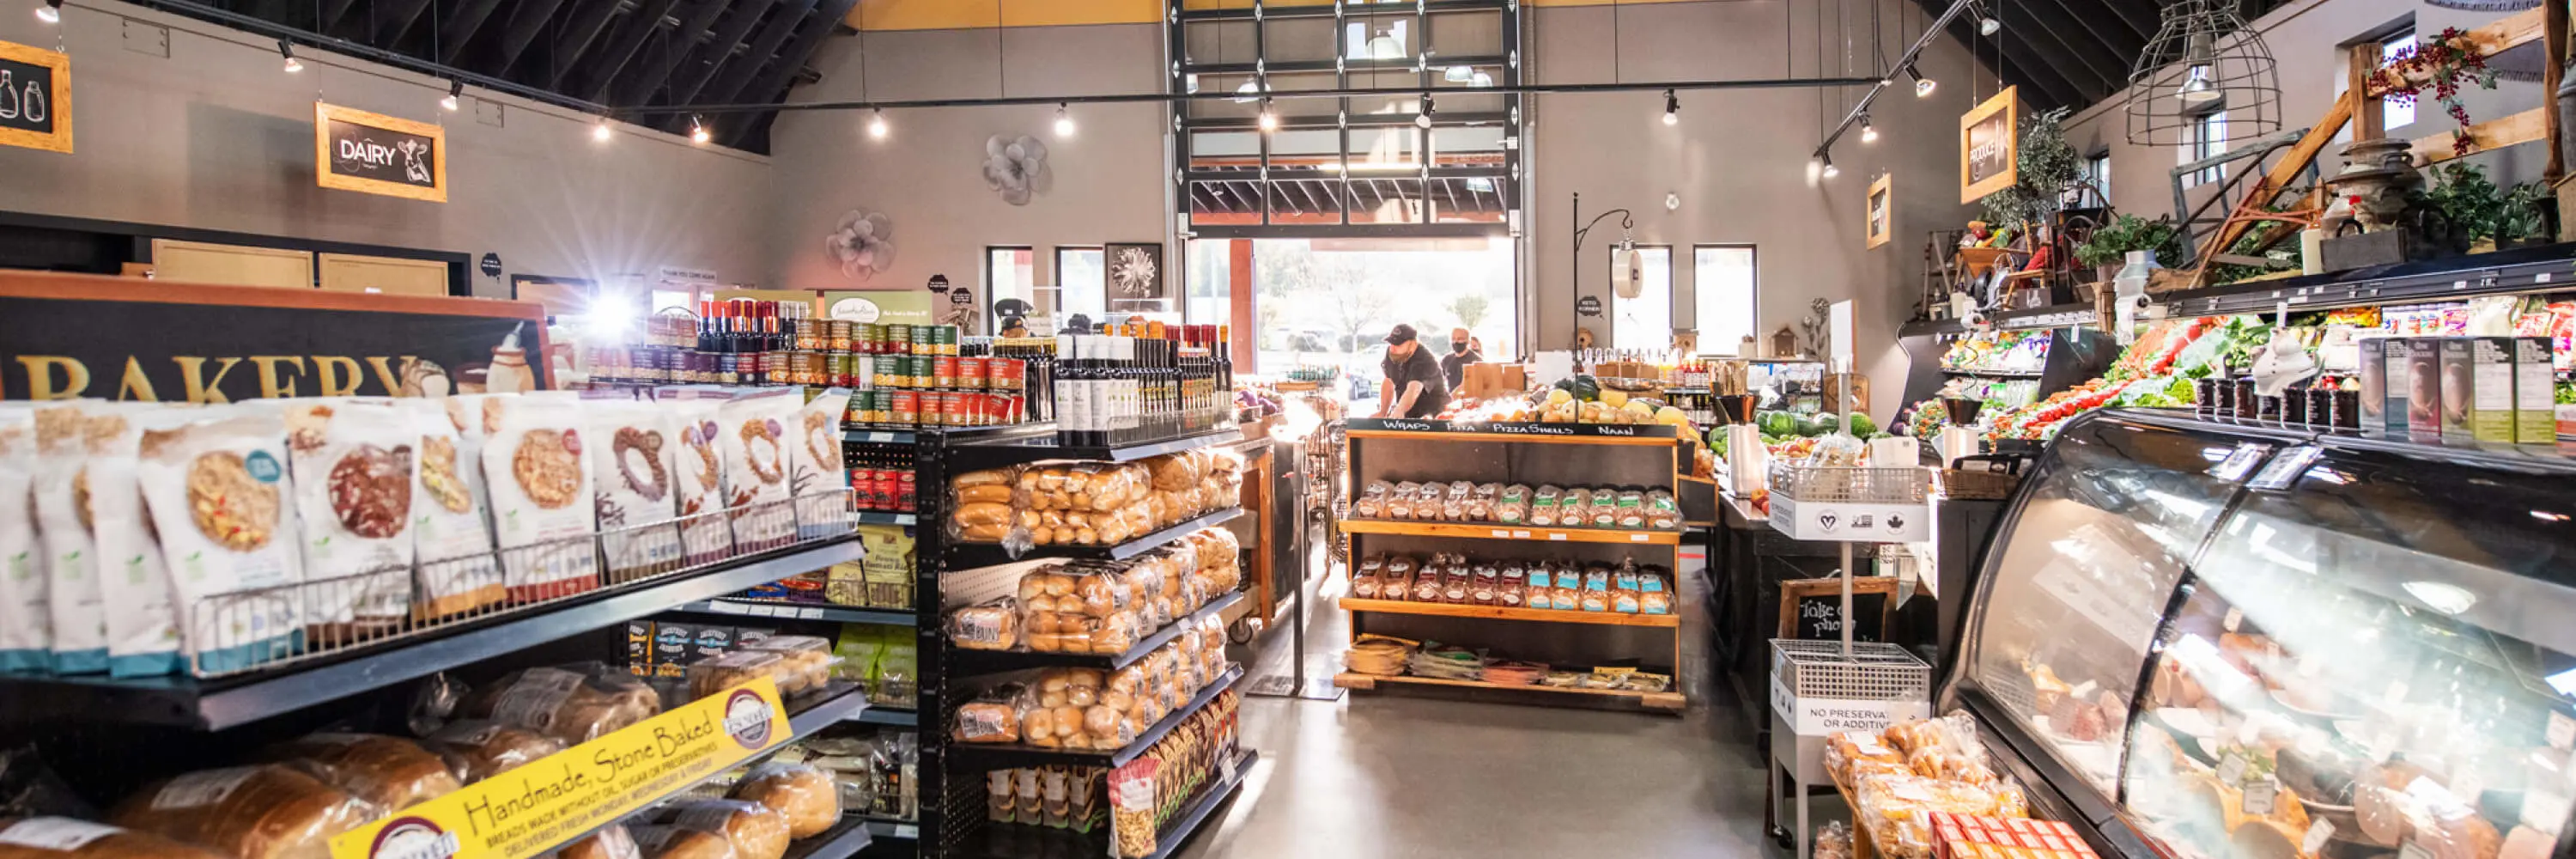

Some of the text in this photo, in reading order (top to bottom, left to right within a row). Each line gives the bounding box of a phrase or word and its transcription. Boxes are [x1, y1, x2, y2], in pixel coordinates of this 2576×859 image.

[339, 138, 396, 166] DAIRY
[1969, 139, 1995, 166] PRODUCE
[1809, 708, 1827, 718] NO
[1823, 718, 1892, 729] OR ADDITIV
[463, 763, 593, 837] Handmade,
[594, 745, 655, 783] Stone
[653, 710, 714, 758] Baked
